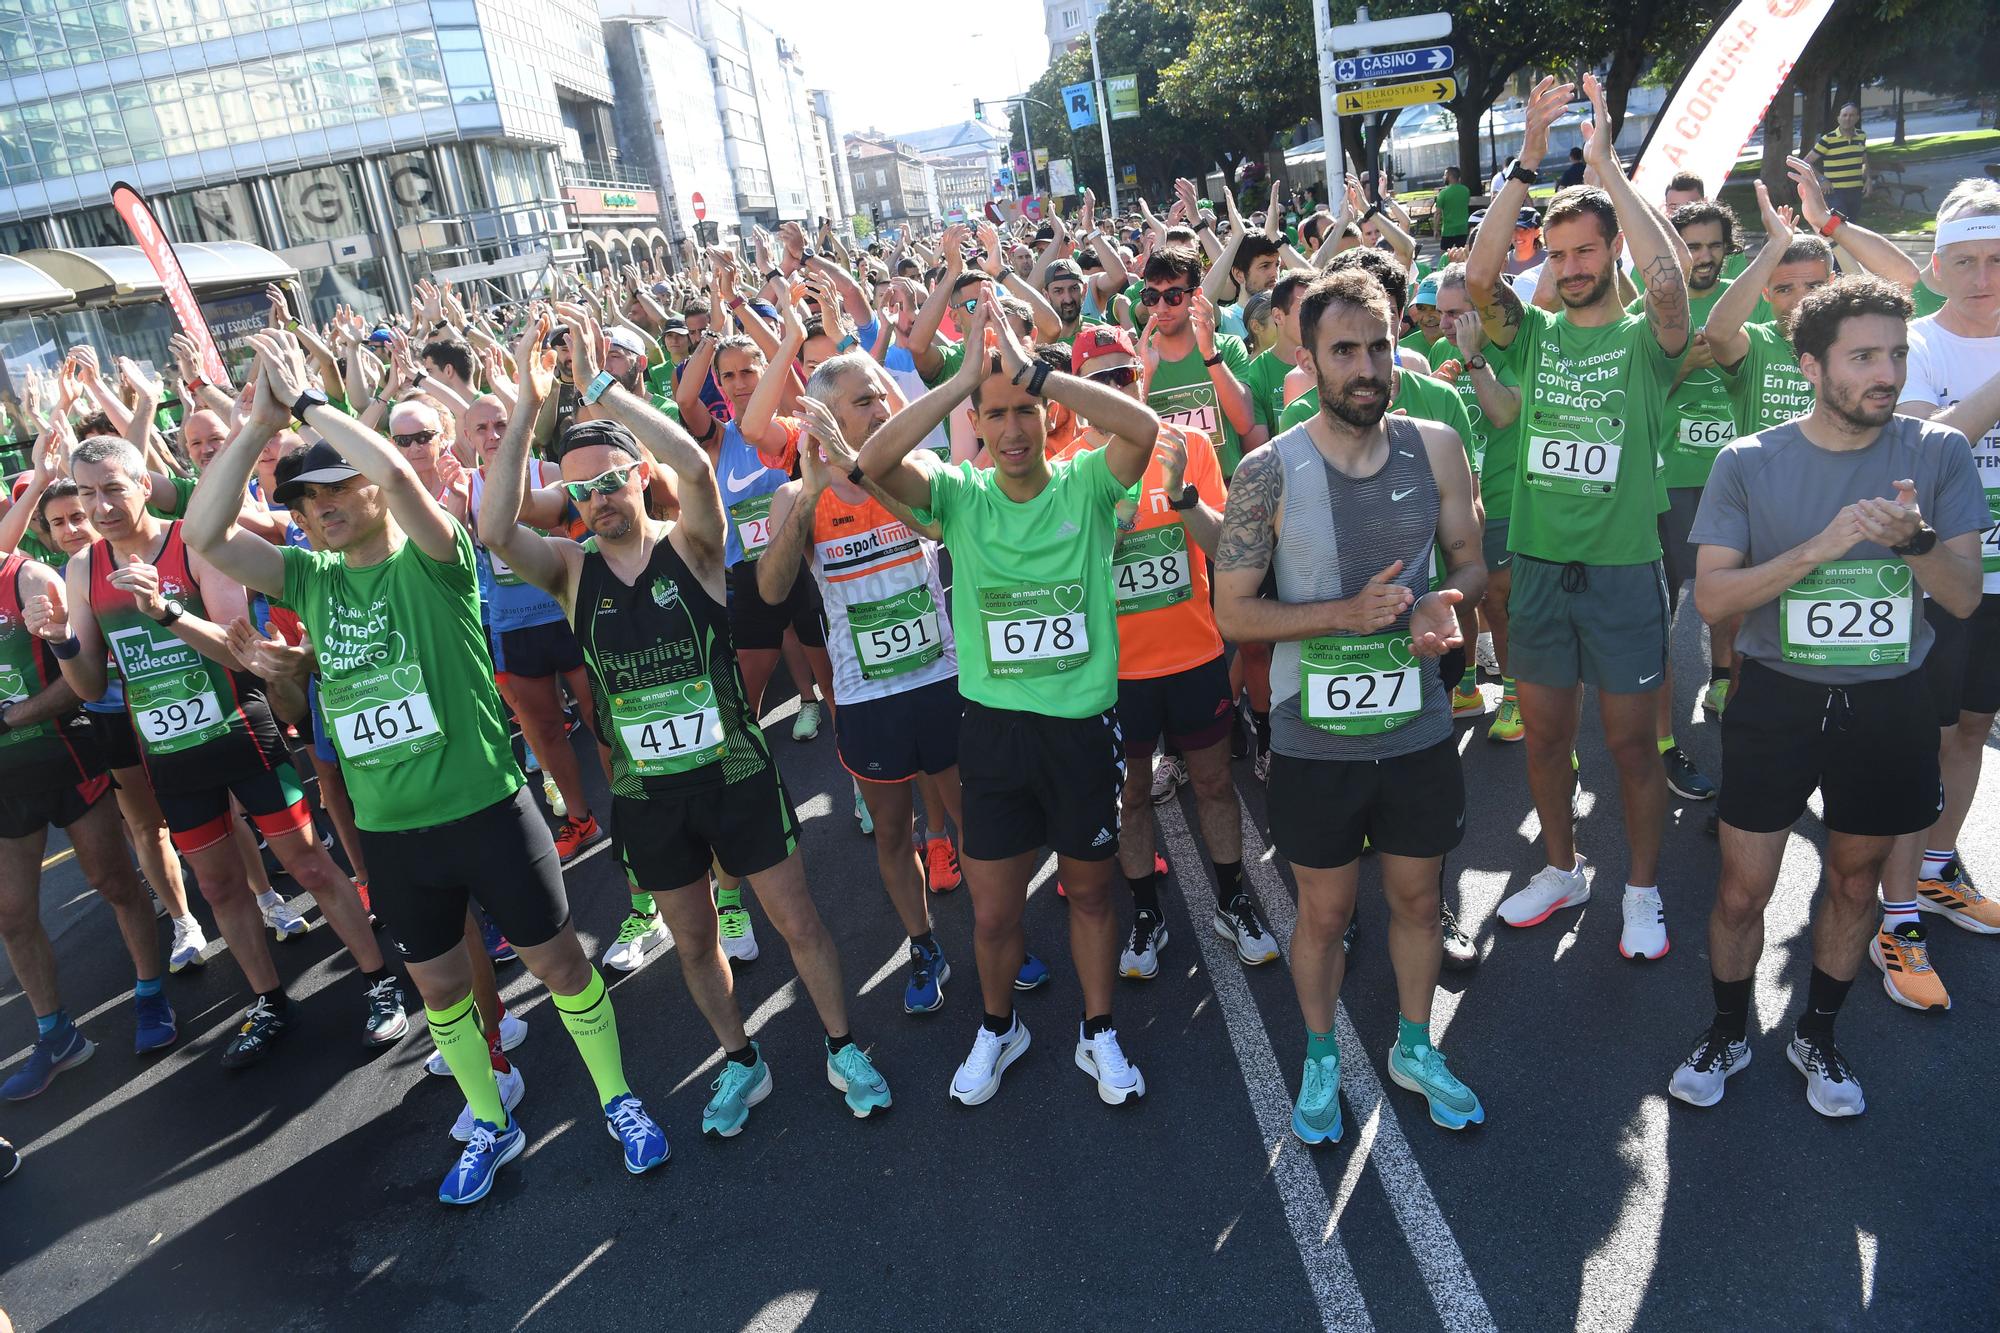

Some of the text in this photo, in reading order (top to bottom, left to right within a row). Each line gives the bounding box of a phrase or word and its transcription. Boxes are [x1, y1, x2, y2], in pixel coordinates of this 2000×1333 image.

[1361, 53, 1417, 71] CASINO
[1111, 80, 1135, 91] 7KM
[1366, 84, 1425, 99] EUROSTARS
[1662, 19, 1757, 168] A CORUÑA
[1588, 348, 1627, 365] EDICIÓN
[1537, 372, 1581, 392] contra
[1763, 375, 1784, 388] En
[1535, 388, 1544, 399] o
[1762, 392, 1810, 406] contra
[1570, 414, 1594, 423] marcha
[1761, 408, 1770, 418] o
[1688, 421, 1734, 443] 664
[1542, 440, 1607, 475] 610
[826, 526, 913, 560] nosportlimit
[1132, 532, 1156, 543] marcha
[1118, 555, 1180, 592] 438
[1825, 566, 1873, 576] en marcha
[1825, 577, 1856, 585] cancro
[1023, 588, 1050, 597] marcha
[885, 598, 906, 609] marcha
[1013, 599, 1038, 607] cancro
[1807, 600, 1894, 638] 628
[871, 618, 931, 658] 591
[1004, 617, 1074, 655] 678
[122, 642, 146, 659] by
[1353, 641, 1385, 651] marcha
[600, 638, 695, 672] Running
[1308, 652, 1334, 660] contra
[1342, 652, 1370, 660] cancro
[1798, 651, 1807, 659] de
[1808, 651, 1827, 660] Maio
[1009, 666, 1024, 674] Maio
[158, 679, 180, 689] marcha
[352, 681, 362, 689] en
[363, 672, 389, 686] marcha
[355, 686, 379, 697] cancro
[651, 689, 679, 699] marcha
[1327, 671, 1405, 711] 627
[617, 704, 637, 713] contra
[644, 701, 668, 711] cancro
[149, 698, 211, 736] 392
[353, 699, 423, 744] 461
[641, 712, 704, 753] 417
[1329, 723, 1347, 731] Maio
